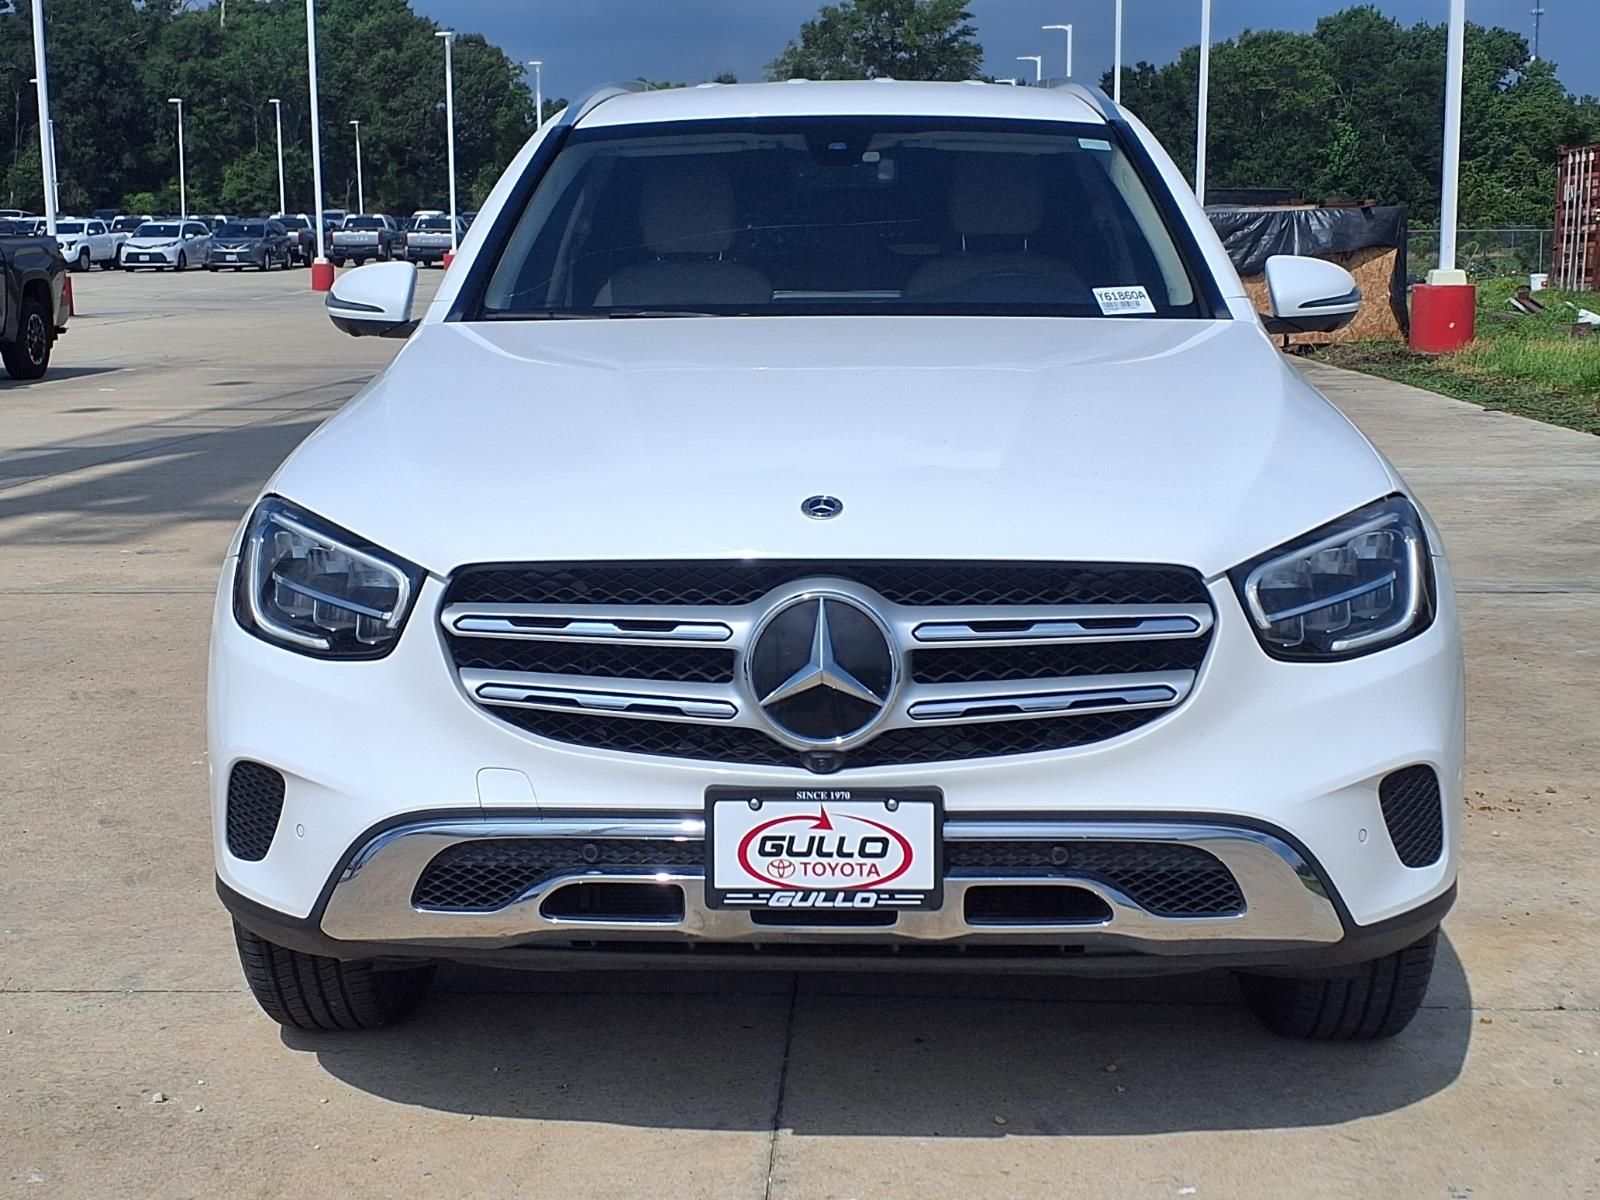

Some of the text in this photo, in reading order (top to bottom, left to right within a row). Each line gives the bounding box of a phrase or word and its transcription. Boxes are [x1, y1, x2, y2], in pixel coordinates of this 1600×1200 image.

[1097, 290, 1147, 302] Y61860A
[796, 791, 851, 800] SINCE 1970
[758, 835, 890, 859] GULLO
[800, 862, 881, 877] TOYOTA
[767, 891, 878, 908] GULLO
